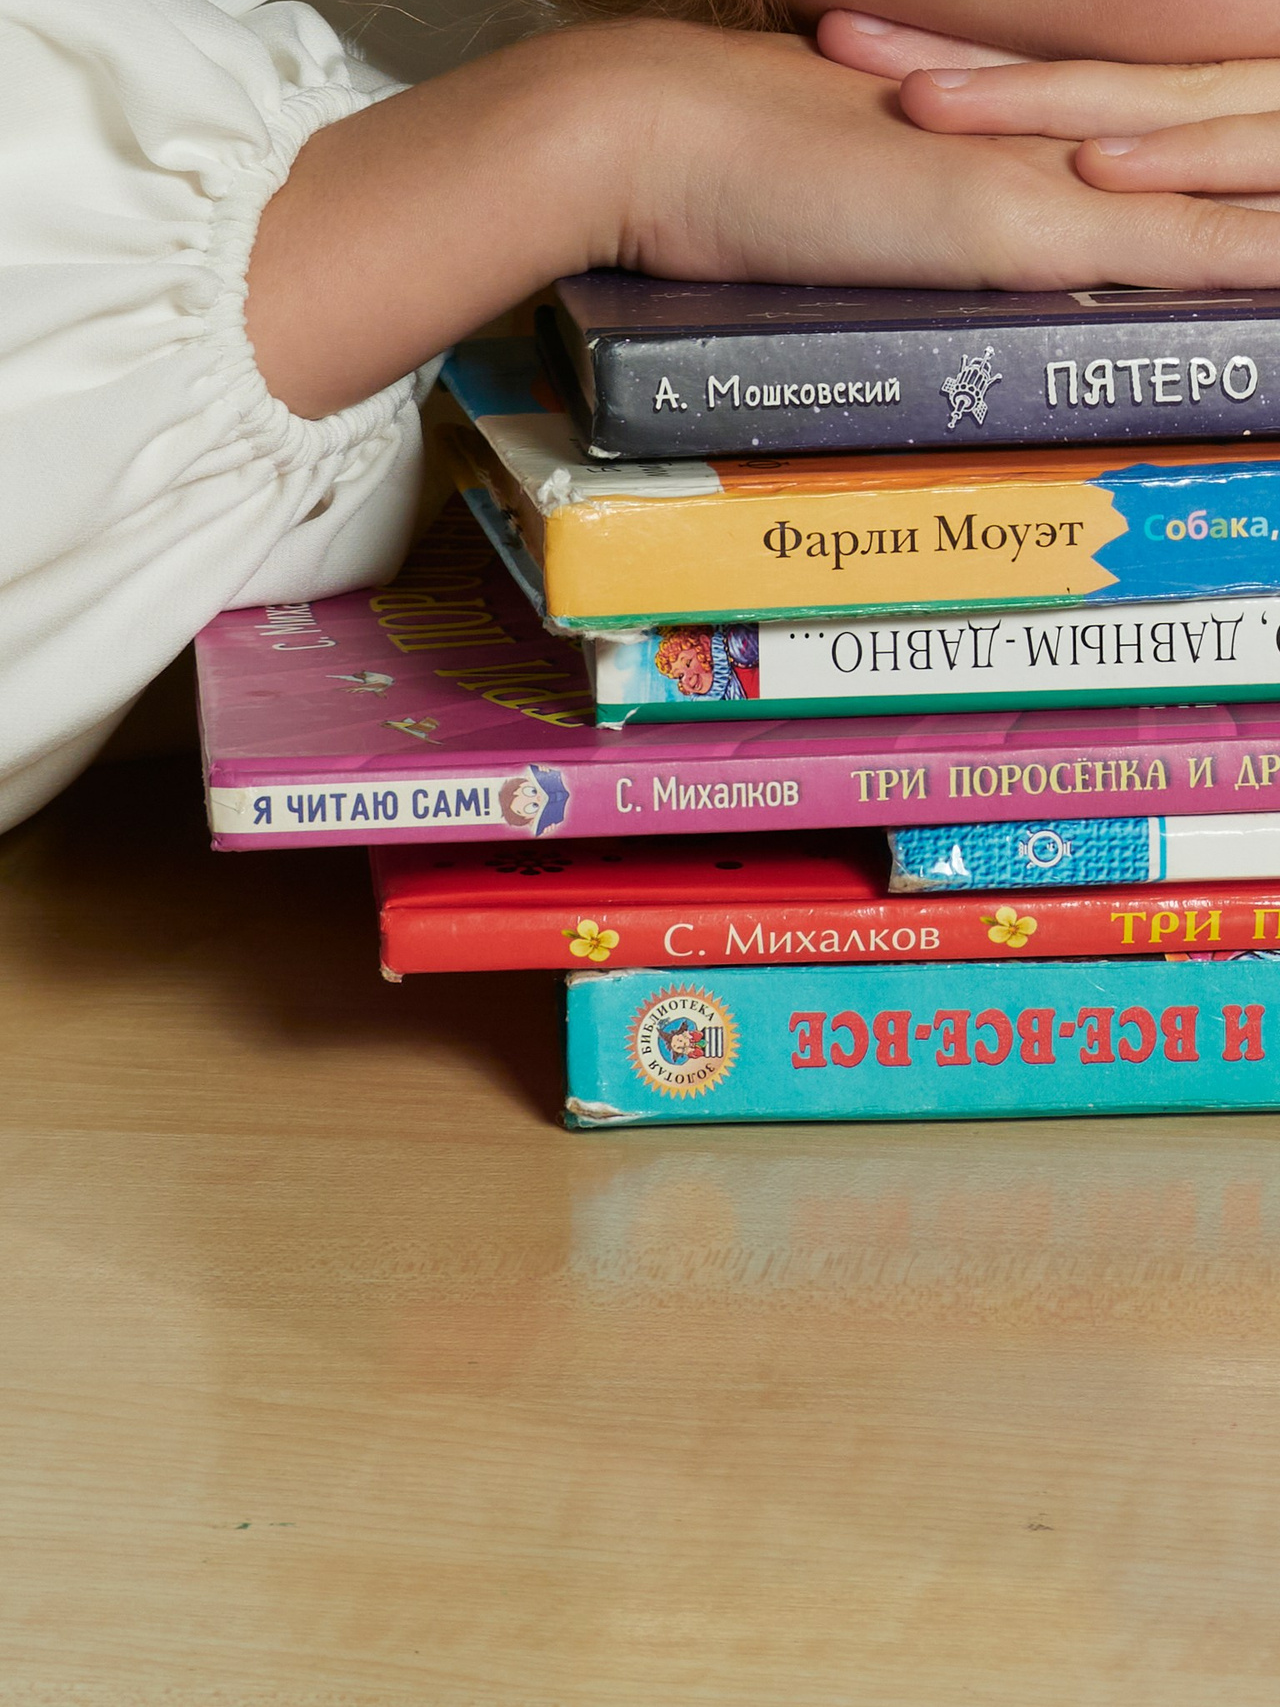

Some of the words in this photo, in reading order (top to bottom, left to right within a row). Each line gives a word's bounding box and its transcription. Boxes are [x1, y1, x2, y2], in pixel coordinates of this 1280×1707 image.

[654, 376, 688, 411] А.
[707, 375, 900, 409] Мошковский
[1046, 355, 1258, 406] ПЯТЕРО
[762, 520, 920, 571] Фарли
[933, 513, 1085, 563] Моуэт
[1143, 509, 1280, 542] Собака,
[615, 777, 642, 813] С.
[652, 776, 800, 812] Михалков
[850, 768, 928, 802] ТРИ
[948, 757, 1168, 798] ПОРОСЁНКА
[1187, 756, 1215, 789] И
[253, 796, 273, 825] Я
[286, 790, 399, 824] ЧИТАЮ
[411, 787, 491, 820] САМ!
[663, 922, 706, 957] С.
[724, 922, 941, 955] Михалков
[1110, 909, 1223, 945] ТРИ
[641, 998, 715, 1055] БИБЛИОТЕКА
[788, 1004, 1200, 1069] ВСЕ-ВСЕ-ВСЕ
[1221, 1003, 1266, 1061] И
[648, 1060, 716, 1084] ЗОЛОТАЯ
